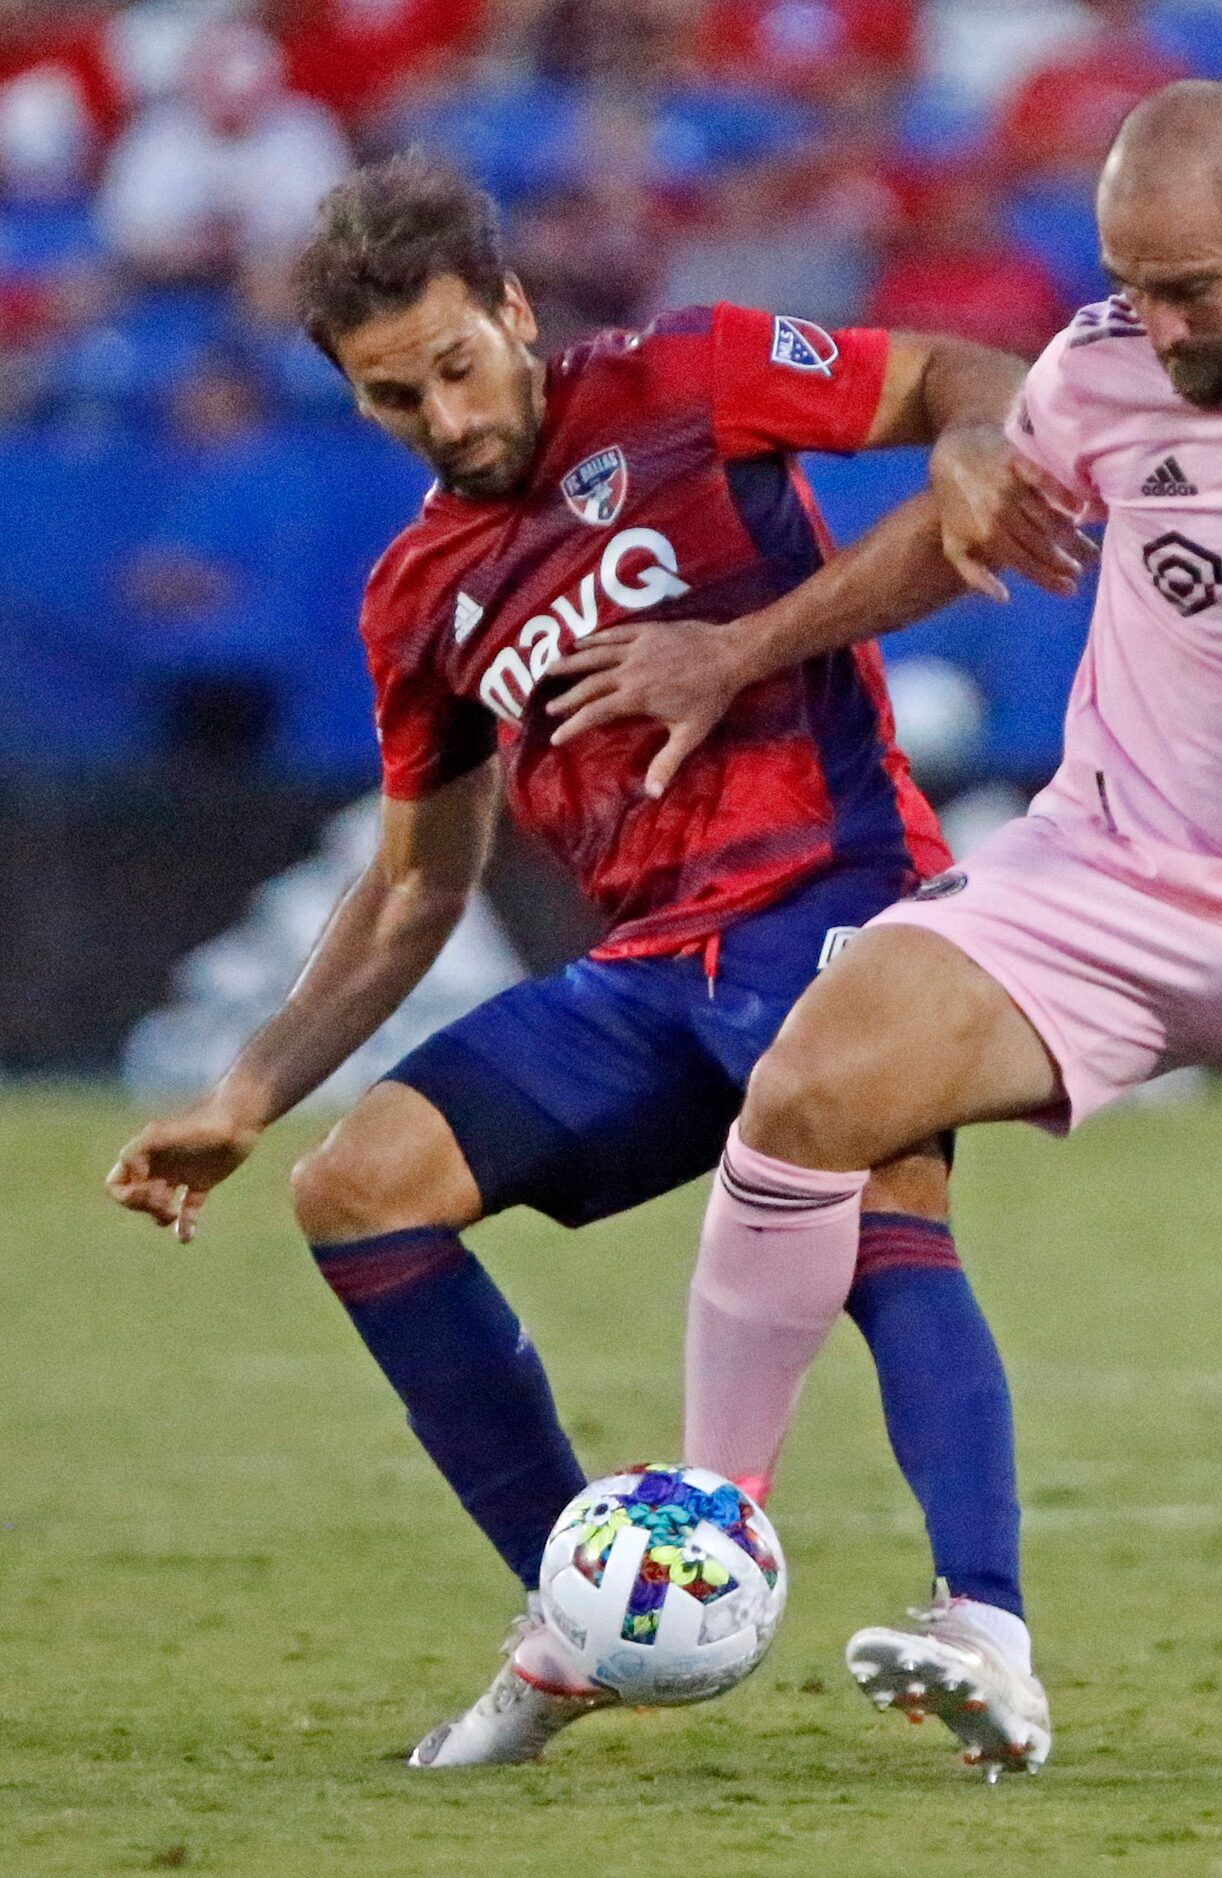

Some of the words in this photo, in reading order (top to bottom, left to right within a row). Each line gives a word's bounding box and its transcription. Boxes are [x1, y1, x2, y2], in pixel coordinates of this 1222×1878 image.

[777, 329, 794, 360] MLS
[579, 450, 619, 483] DALLAS
[1141, 480, 1199, 497] adidas
